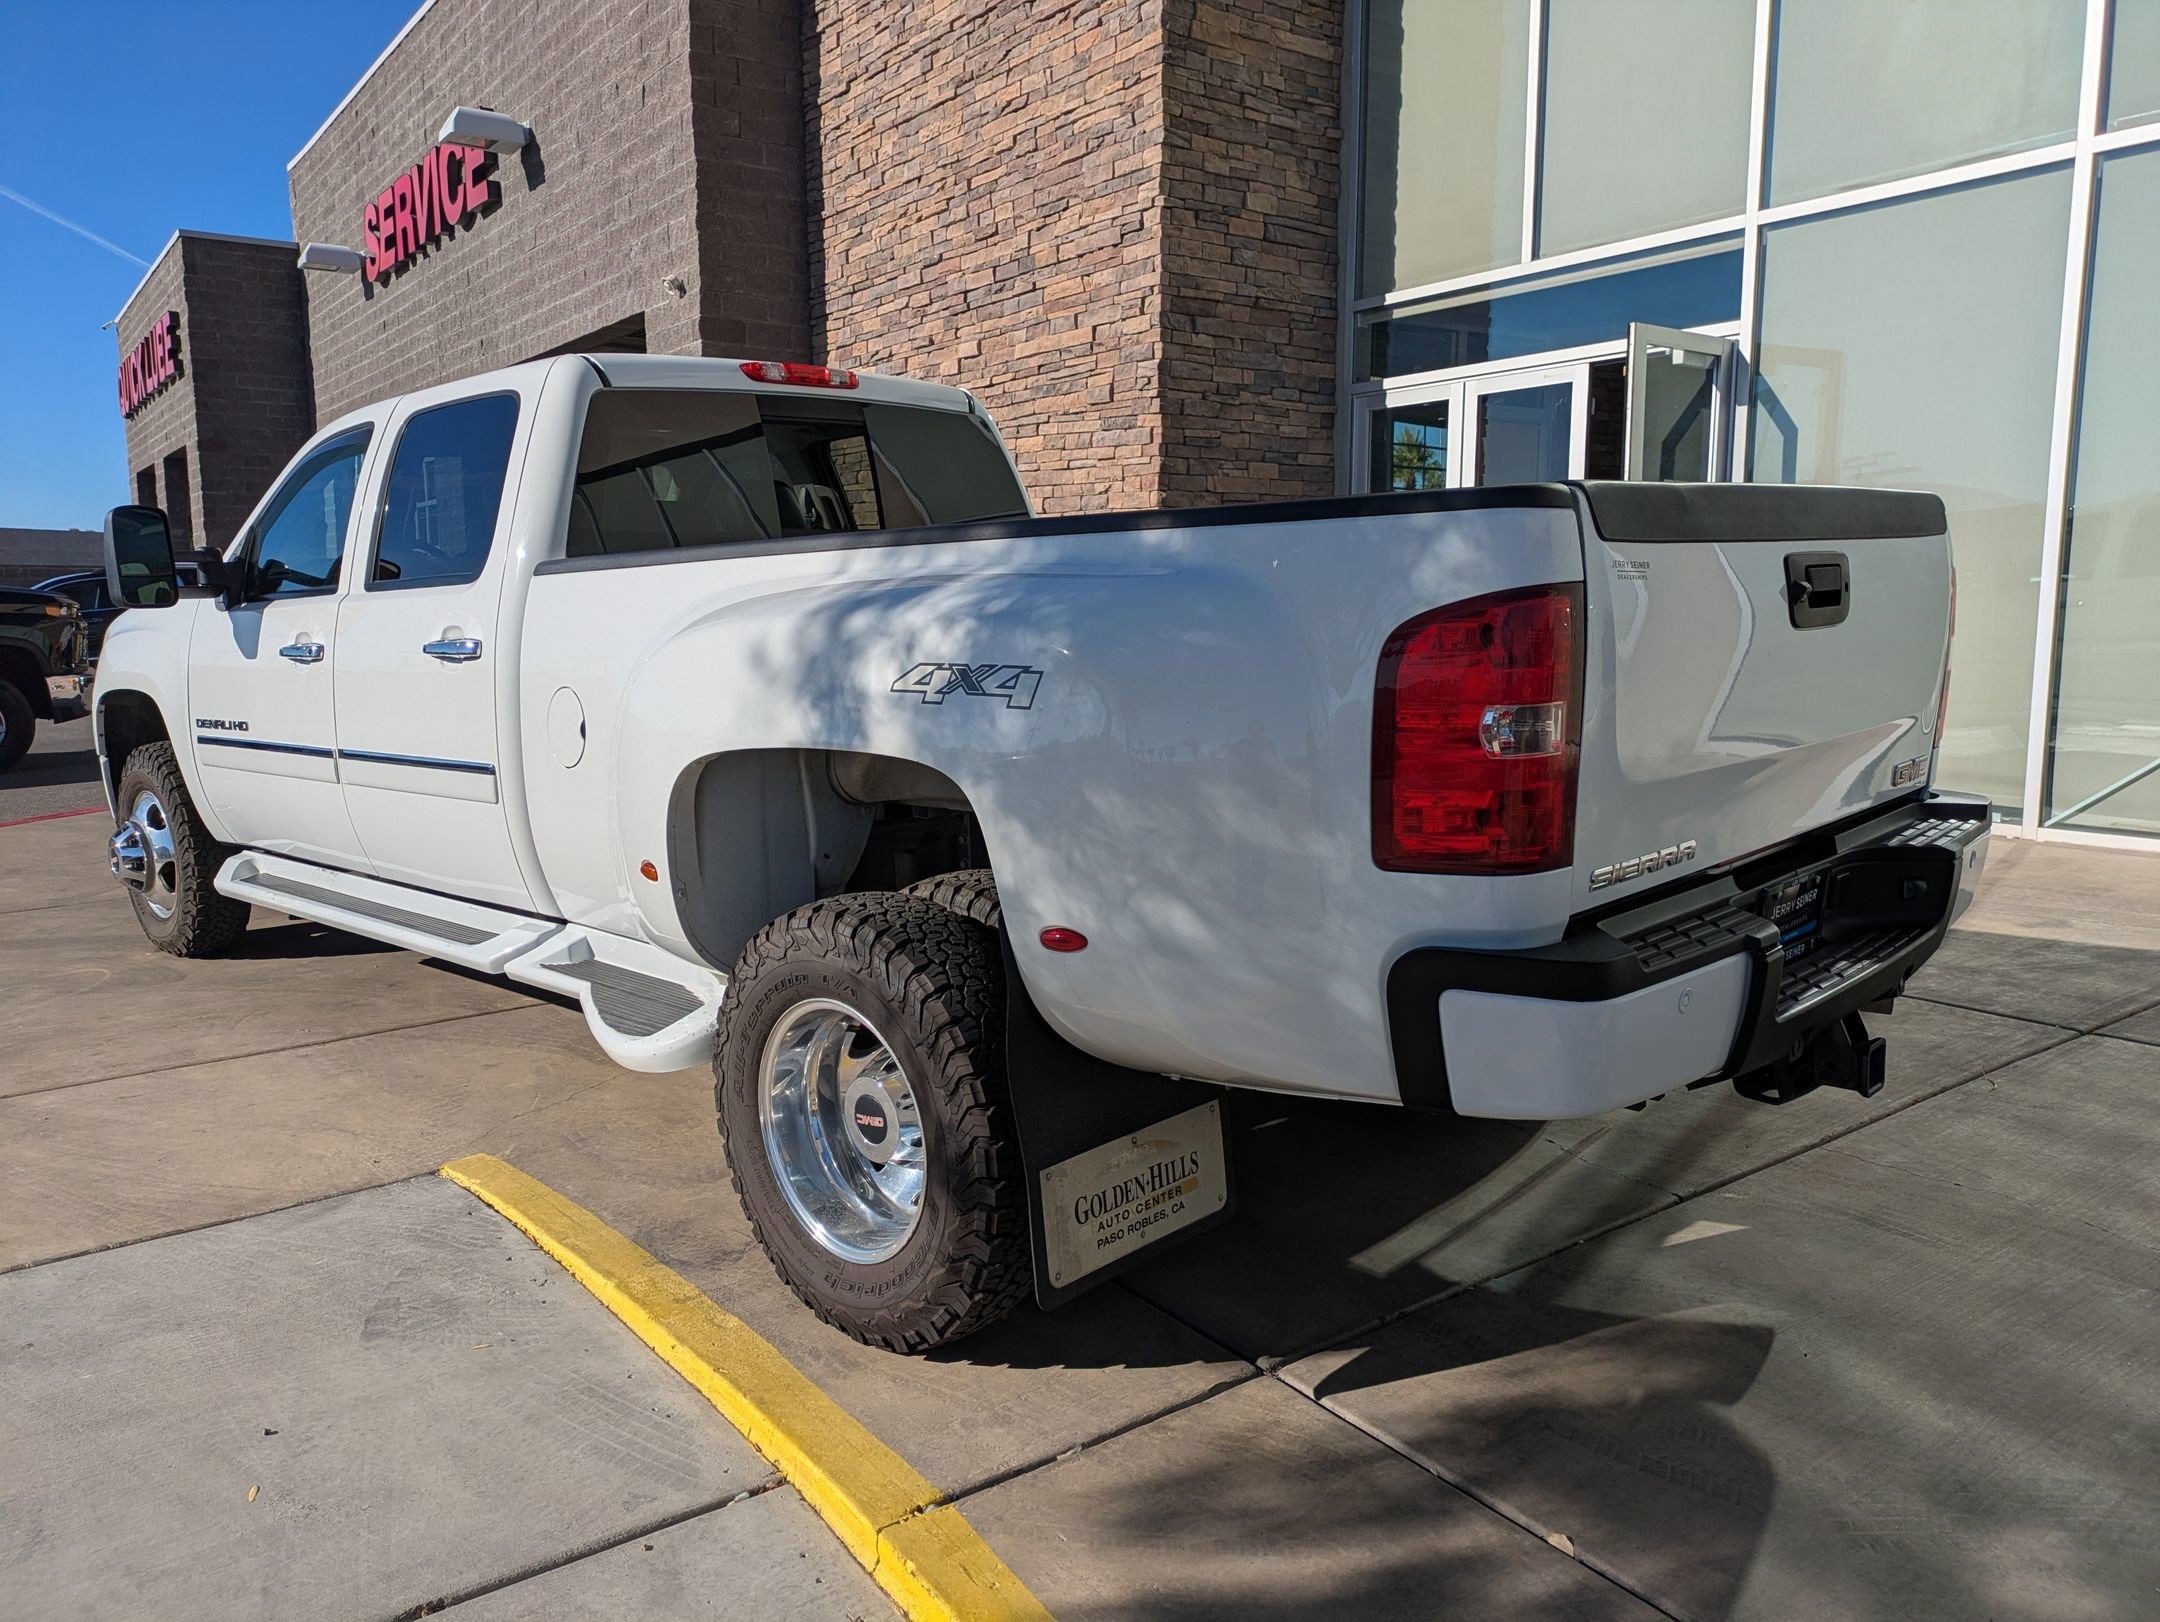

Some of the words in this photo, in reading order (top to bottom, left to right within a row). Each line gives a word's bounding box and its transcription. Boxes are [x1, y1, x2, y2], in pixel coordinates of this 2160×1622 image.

[364, 142, 489, 282] SERVICE
[118, 342, 147, 417] QUICK
[144, 311, 175, 394] LUBE
[1611, 560, 1630, 569] JERRY
[1630, 560, 1651, 570] SEINER
[196, 718, 233, 731] DENALI
[233, 720, 249, 732] HD
[1891, 754, 1928, 787] GMC
[1589, 839, 1697, 893] SIERRA
[1770, 900, 1796, 920] JERRY
[1795, 888, 1818, 910] SEINER
[856, 1113, 884, 1128] GMC
[1097, 1209, 1131, 1233] AUTO
[1135, 1185, 1183, 1215] CENTER
[1097, 1228, 1125, 1251] PASO
[1127, 1209, 1170, 1236] ROBLES,
[1171, 1200, 1186, 1215] CA
